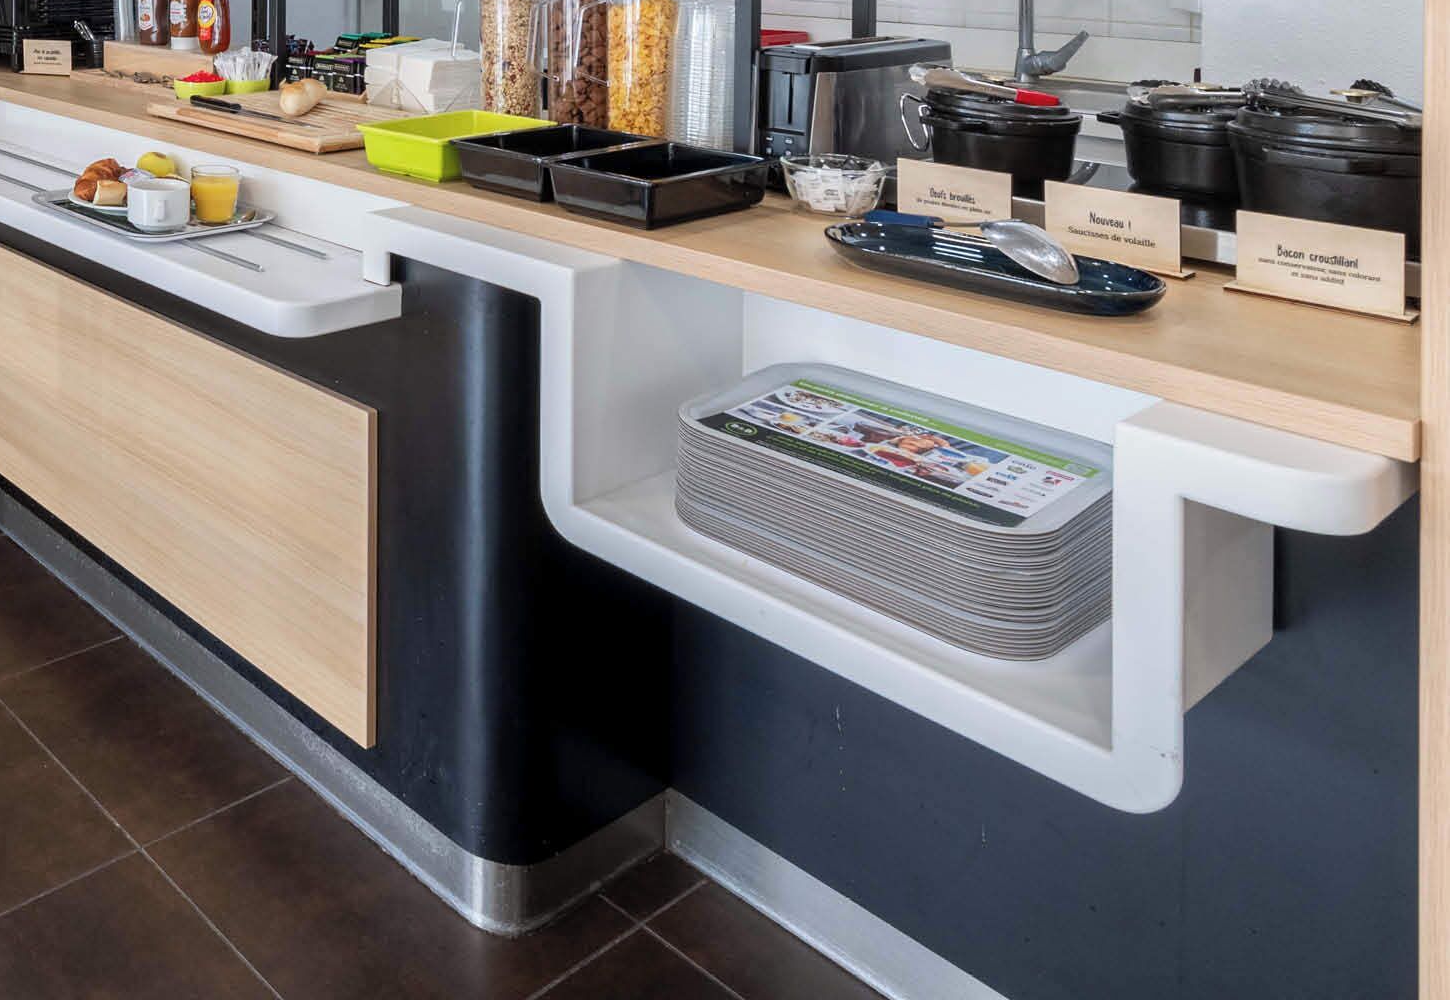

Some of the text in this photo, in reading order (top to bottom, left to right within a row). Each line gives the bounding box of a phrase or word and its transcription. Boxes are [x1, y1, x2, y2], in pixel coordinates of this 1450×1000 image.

[1089, 211, 1125, 229] Nouveau
[1068, 225, 1157, 249] Saucisses de volaille
[1277, 244, 1359, 270] Bacon croustillant
